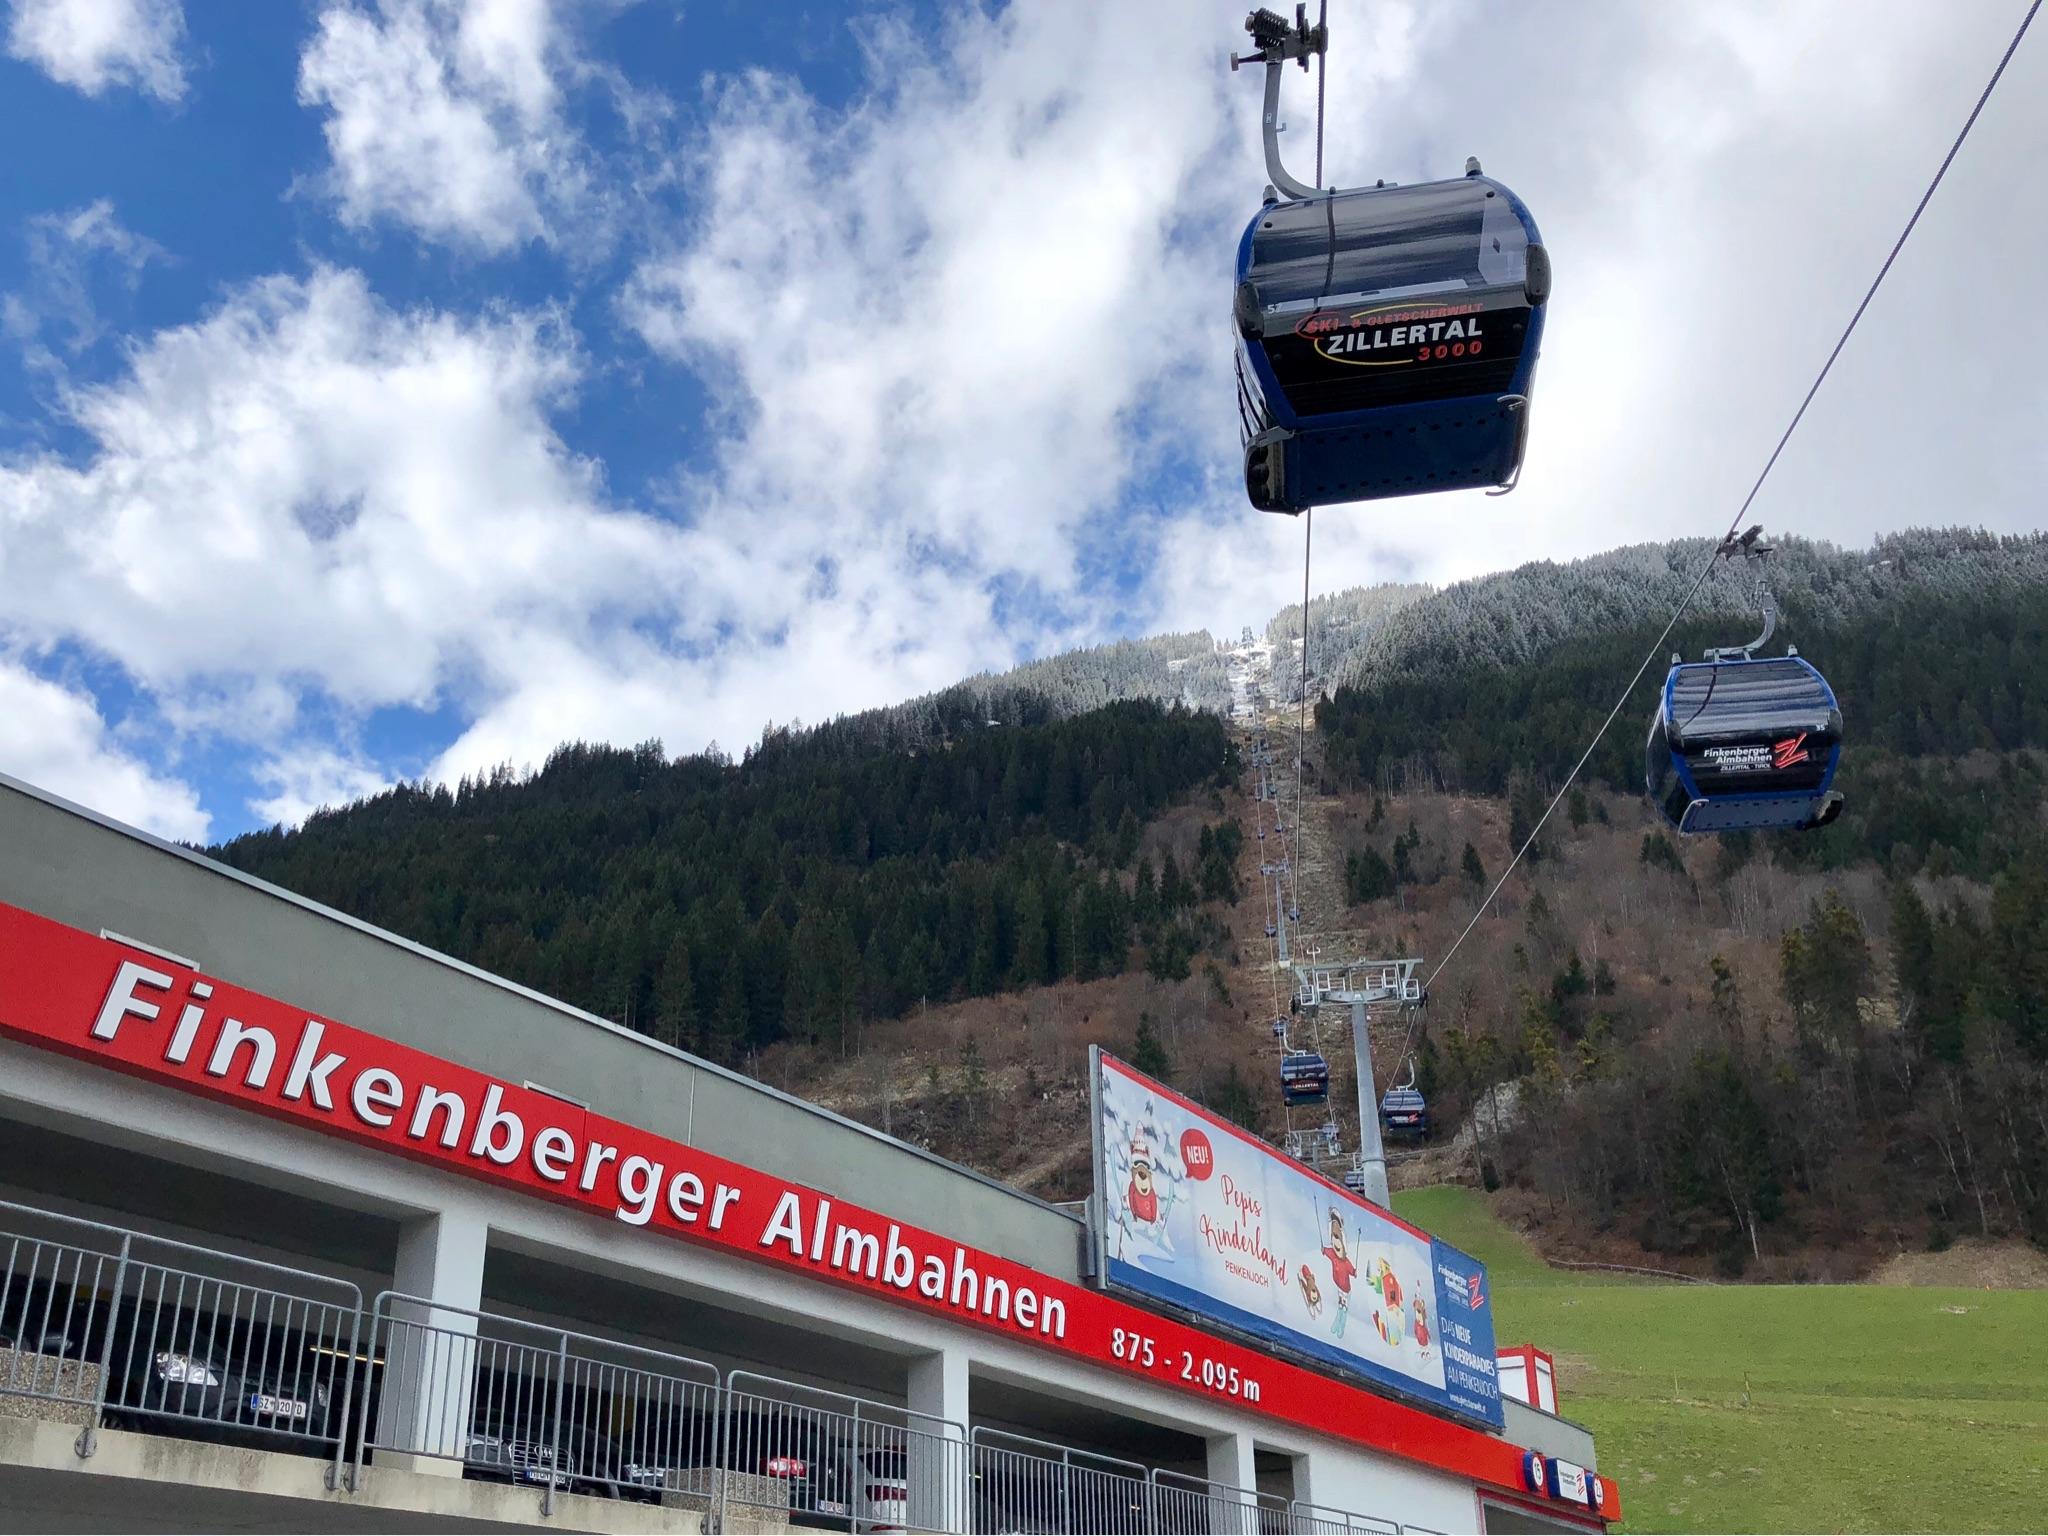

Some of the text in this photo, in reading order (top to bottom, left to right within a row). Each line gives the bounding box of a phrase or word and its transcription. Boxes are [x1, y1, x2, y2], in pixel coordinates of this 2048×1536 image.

[1327, 318, 1483, 355] ZILLERTAL
[1418, 340, 1482, 360] 3000
[1704, 746, 1770, 758] Finkenberger
[1716, 754, 1772, 764] Almbahnen
[90, 959, 1066, 1339] Finkenberger Almbahnen
[1186, 1145, 1209, 1164] NEU!
[1221, 1174, 1262, 1227] Pepis
[1200, 1214, 1288, 1285] Kinderland
[1225, 1260, 1269, 1287] PENKENJOCH
[1441, 1317, 1455, 1337] DAS
[1112, 1328, 1155, 1367] 875
[1181, 1351, 1240, 1395] 2.095
[1243, 1378, 1260, 1402] m
[1444, 1341, 1495, 1376] KINDERPARADIES
[1459, 1371, 1498, 1400] PENKENJOCH
